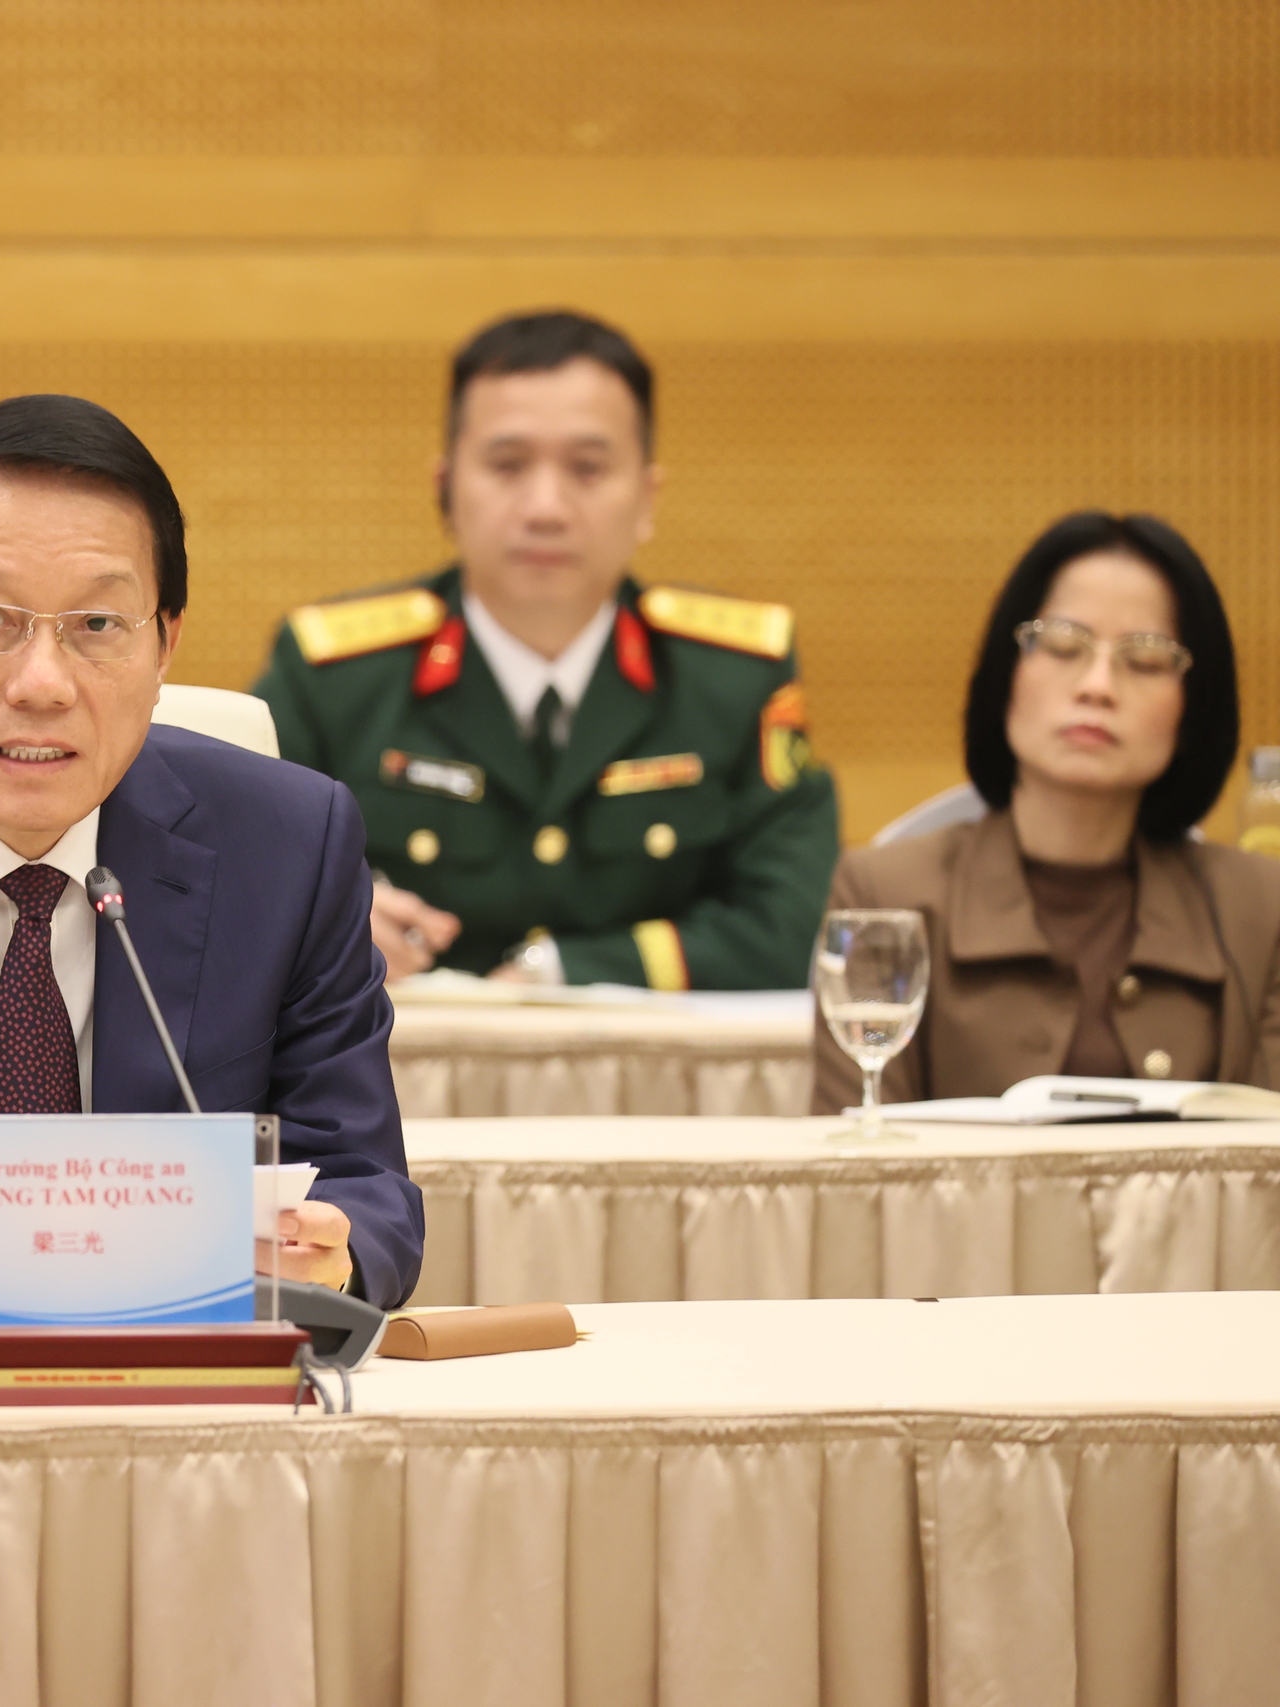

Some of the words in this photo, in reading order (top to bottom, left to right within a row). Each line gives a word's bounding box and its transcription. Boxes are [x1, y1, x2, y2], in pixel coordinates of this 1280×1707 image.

[65, 1158, 93, 1181] Bộ
[99, 1158, 153, 1180] Công
[161, 1163, 185, 1176] an
[40, 1187, 96, 1205] TAM
[103, 1187, 193, 1209] QUANG
